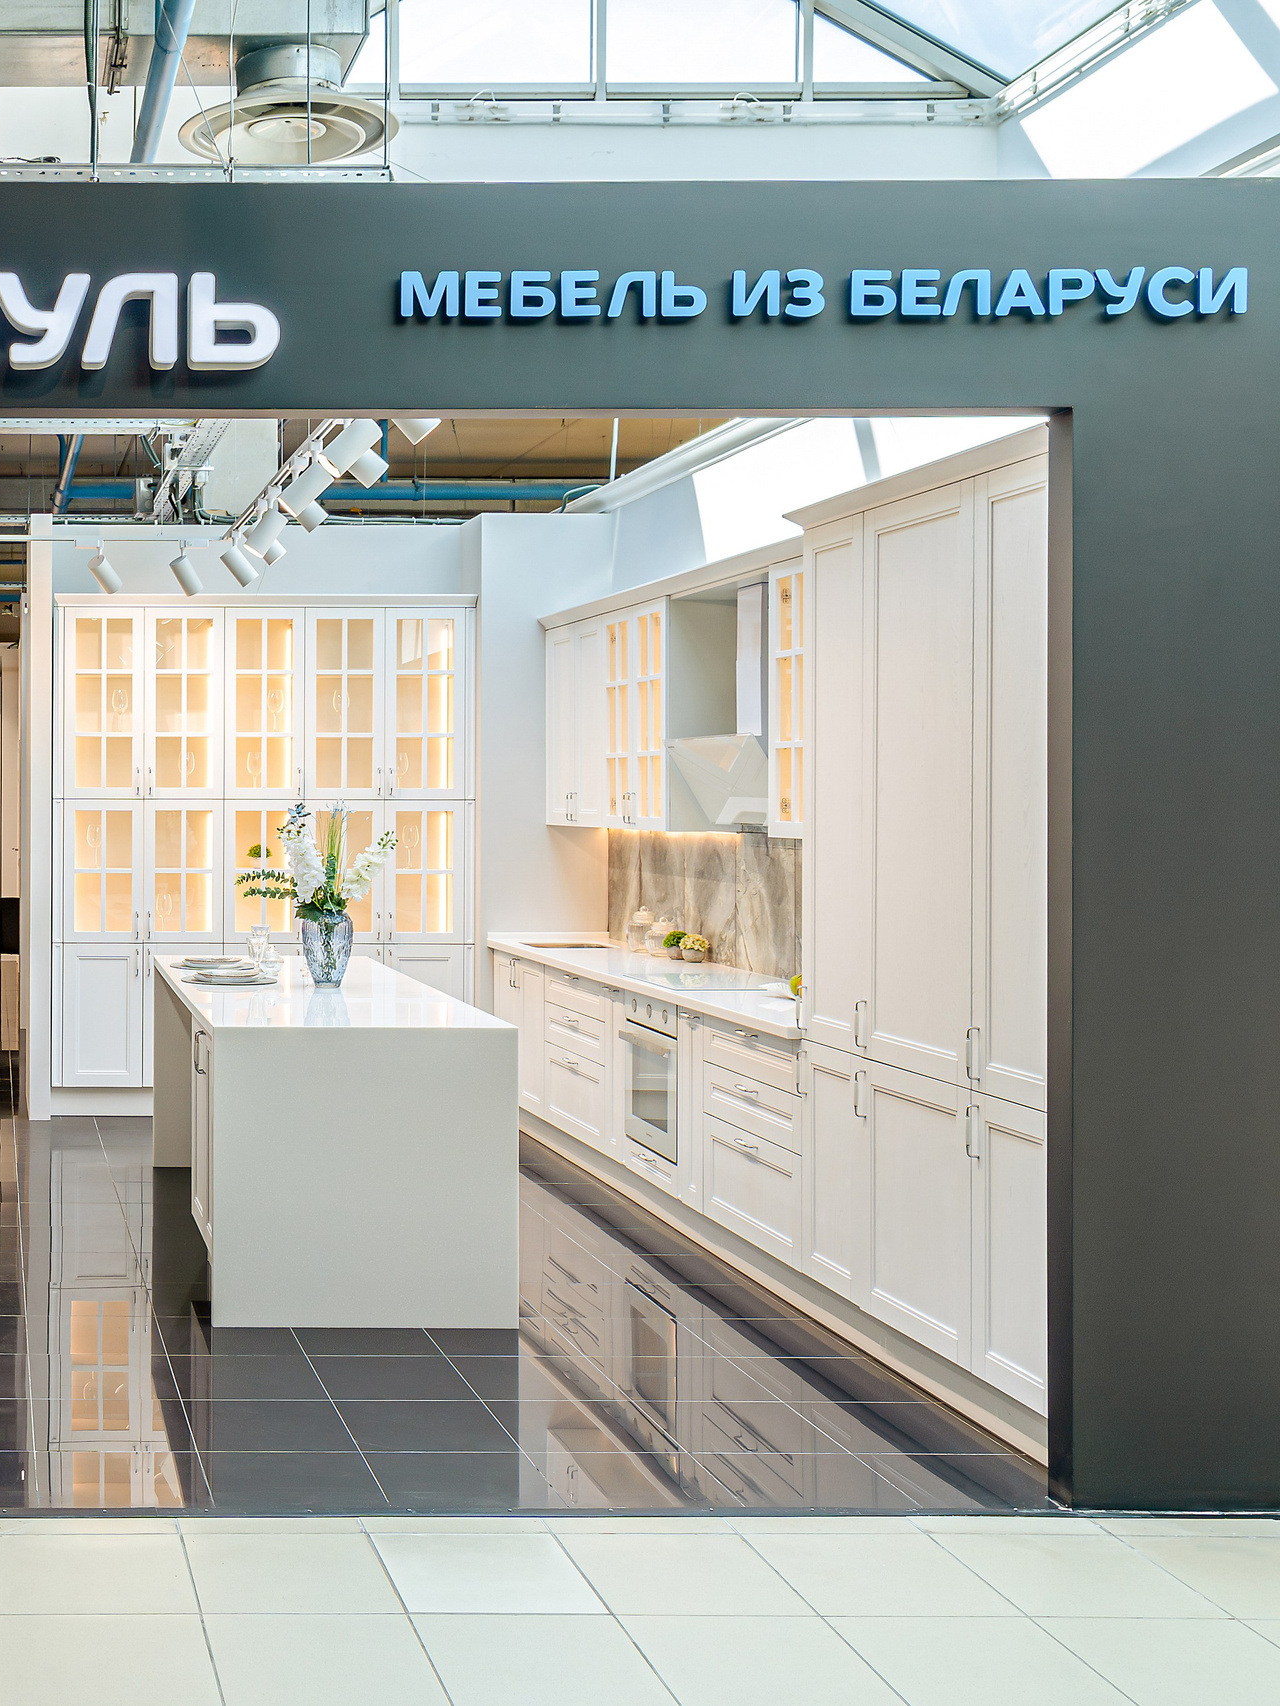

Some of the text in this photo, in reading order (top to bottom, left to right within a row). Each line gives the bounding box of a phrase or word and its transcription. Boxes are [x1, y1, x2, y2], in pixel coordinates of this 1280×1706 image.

[400, 266, 1249, 318] МЕБЕЛЬ ИЗ БЕЛАРУСИ
